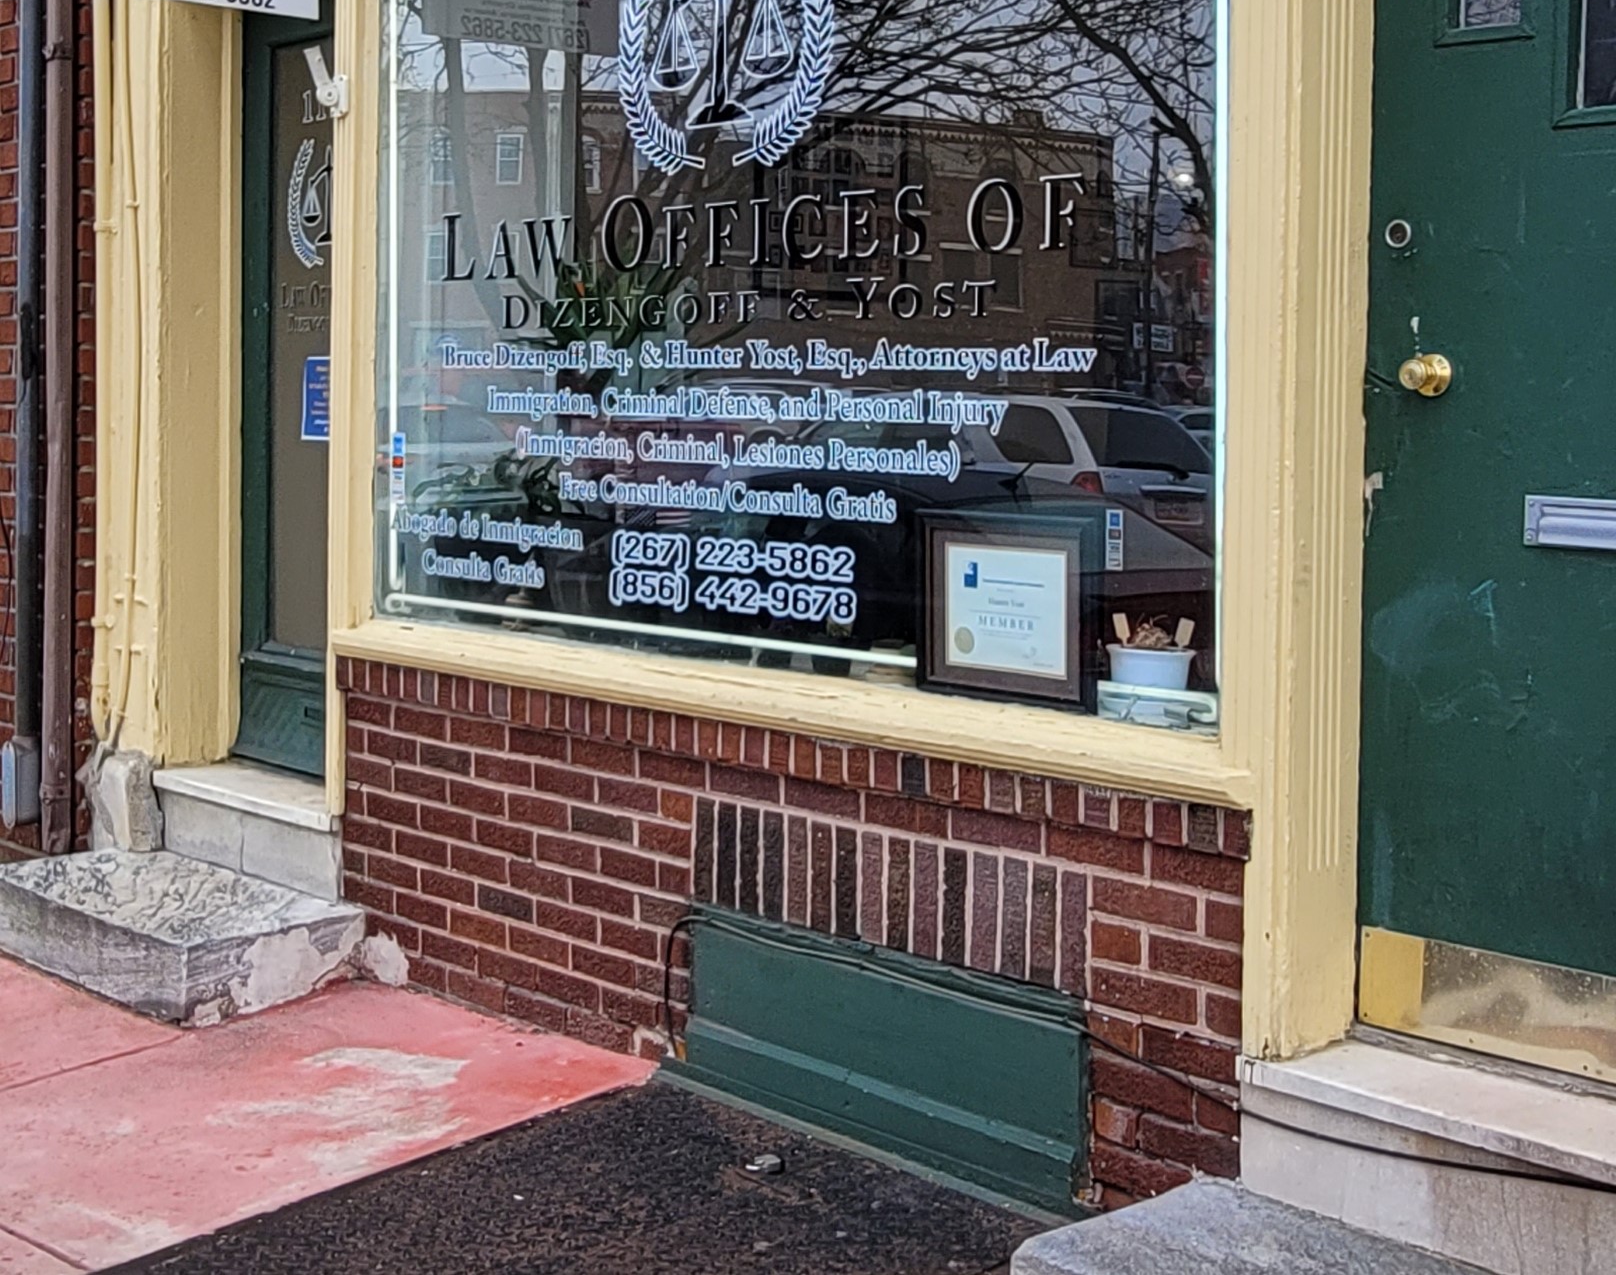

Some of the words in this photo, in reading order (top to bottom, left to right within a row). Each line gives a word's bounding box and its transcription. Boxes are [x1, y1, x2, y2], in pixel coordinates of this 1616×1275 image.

[441, 212, 573, 282] LAW
[601, 184, 928, 273] OFFICES
[966, 173, 1086, 254] OF
[502, 290, 761, 330] DIZENGOFF
[787, 288, 823, 320] &
[846, 277, 997, 319] YOST
[443, 342, 491, 368] Bruce
[493, 341, 588, 373] Dizengoff,
[590, 341, 634, 375] Esq.
[639, 341, 663, 367] &
[665, 339, 743, 369] Hunter
[746, 338, 803, 375] Yost,
[806, 338, 868, 379] Esq.,
[870, 337, 997, 380] Attorneys
[1000, 345, 1029, 372] at
[1033, 337, 1098, 373] Law
[487, 385, 598, 421] Immigration,
[601, 386, 686, 416] Criminal
[688, 387, 775, 423] Defense,
[779, 387, 821, 421] and
[824, 388, 925, 424] Personal
[927, 390, 1008, 436] Injury
[515, 426, 633, 464] (Inmigracion,
[637, 428, 730, 469] Criminal,
[733, 434, 824, 470] Lesiones
[827, 437, 961, 482] Personales)
[558, 472, 598, 501] Free
[600, 475, 823, 517] Consultation/Consulta
[826, 490, 897, 523] Gratis
[391, 505, 456, 541] Abogado
[458, 511, 480, 539] de
[481, 514, 584, 552] Inmigracion
[421, 549, 492, 582] Consulta
[493, 557, 545, 589] Gratis
[611, 530, 690, 571] (267)
[695, 537, 856, 583] 223-5862
[609, 568, 689, 612] (856)
[695, 575, 857, 623] 442-9678
[978, 615, 1035, 631] MEMBER
